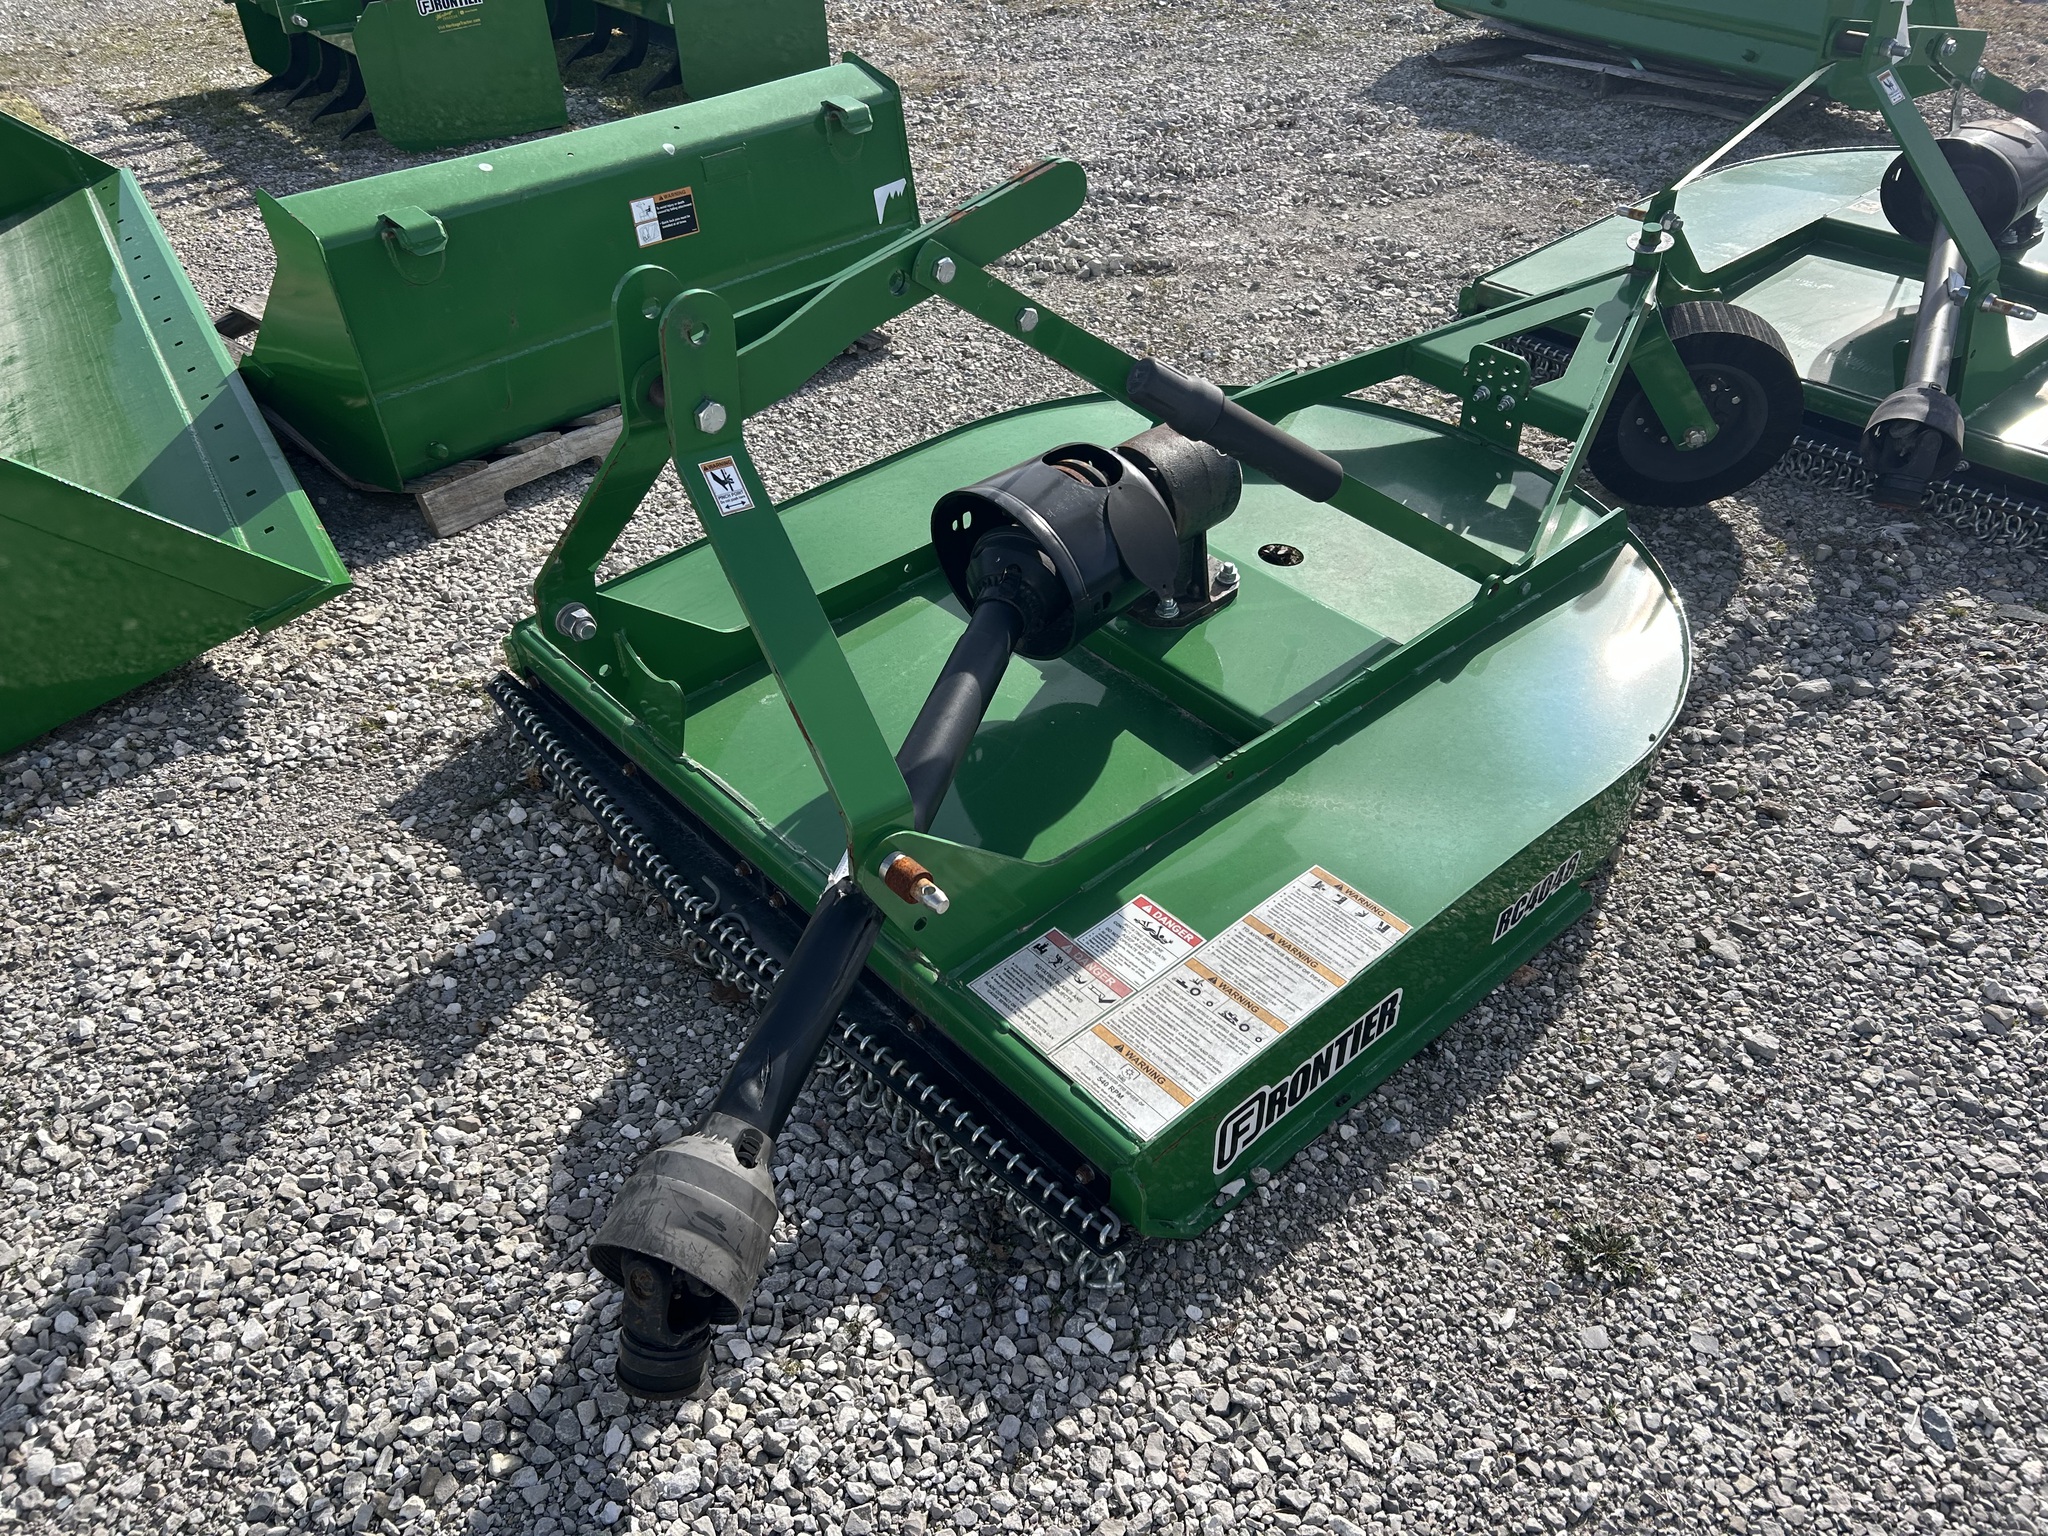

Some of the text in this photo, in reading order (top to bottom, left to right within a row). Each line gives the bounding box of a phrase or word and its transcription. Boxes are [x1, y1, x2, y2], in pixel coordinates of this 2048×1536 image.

[663, 190, 686, 198] WARNING
[708, 460, 731, 469] WARNING
[1343, 888, 1386, 917] WARNING
[1494, 851, 1580, 942] RC4048
[1151, 910, 1195, 942] DANGER
[1071, 952, 1116, 986] DANGER
[1276, 938, 1319, 968] WARNING
[1032, 962, 1084, 1003] ROTATING BLADES AND
[1032, 970, 1074, 1003] THROWN OBJECTS
[1217, 982, 1260, 1013] WARNING
[1124, 1051, 1166, 1085] WARNING
[1217, 993, 1399, 1170] FRONTIER
[1096, 1075, 1124, 1099] 540 RPM
